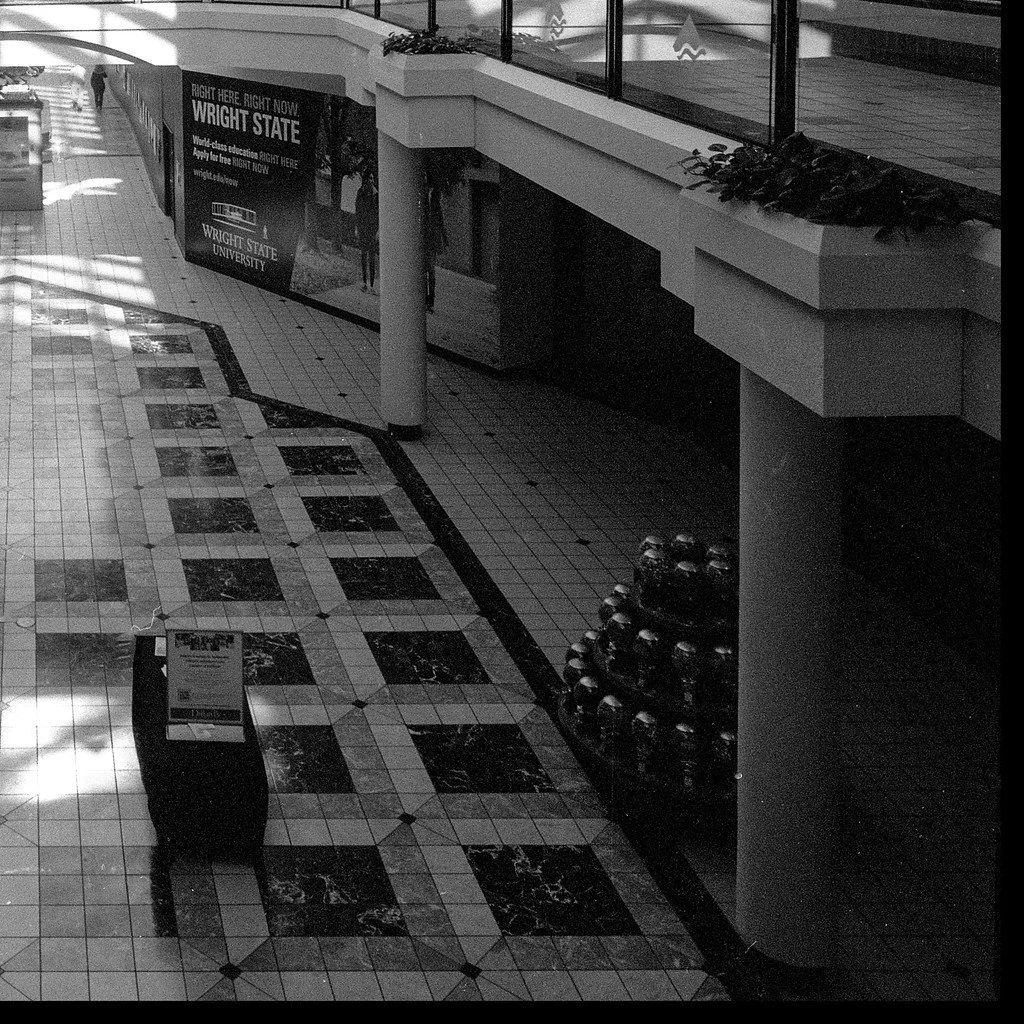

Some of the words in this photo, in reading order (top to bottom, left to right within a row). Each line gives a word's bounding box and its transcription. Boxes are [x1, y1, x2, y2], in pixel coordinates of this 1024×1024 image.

[191, 83, 216, 101] RIGHT
[243, 92, 271, 112] RIGHT
[191, 99, 249, 133] WRIGHT
[252, 111, 301, 145] STATE
[192, 134, 227, 152] World-class
[228, 144, 259, 160] education
[259, 150, 280, 165] RIGHT
[280, 156, 299, 170] HERE
[192, 147, 209, 162] Apply
[209, 150, 218, 162] for
[218, 153, 232, 166] free
[231, 156, 251, 171] RIGHT
[252, 162, 270, 176] NOW
[202, 223, 244, 250] WRIGHT
[246, 237, 278, 262] STATE
[212, 243, 266, 272] UNIVERSITY
